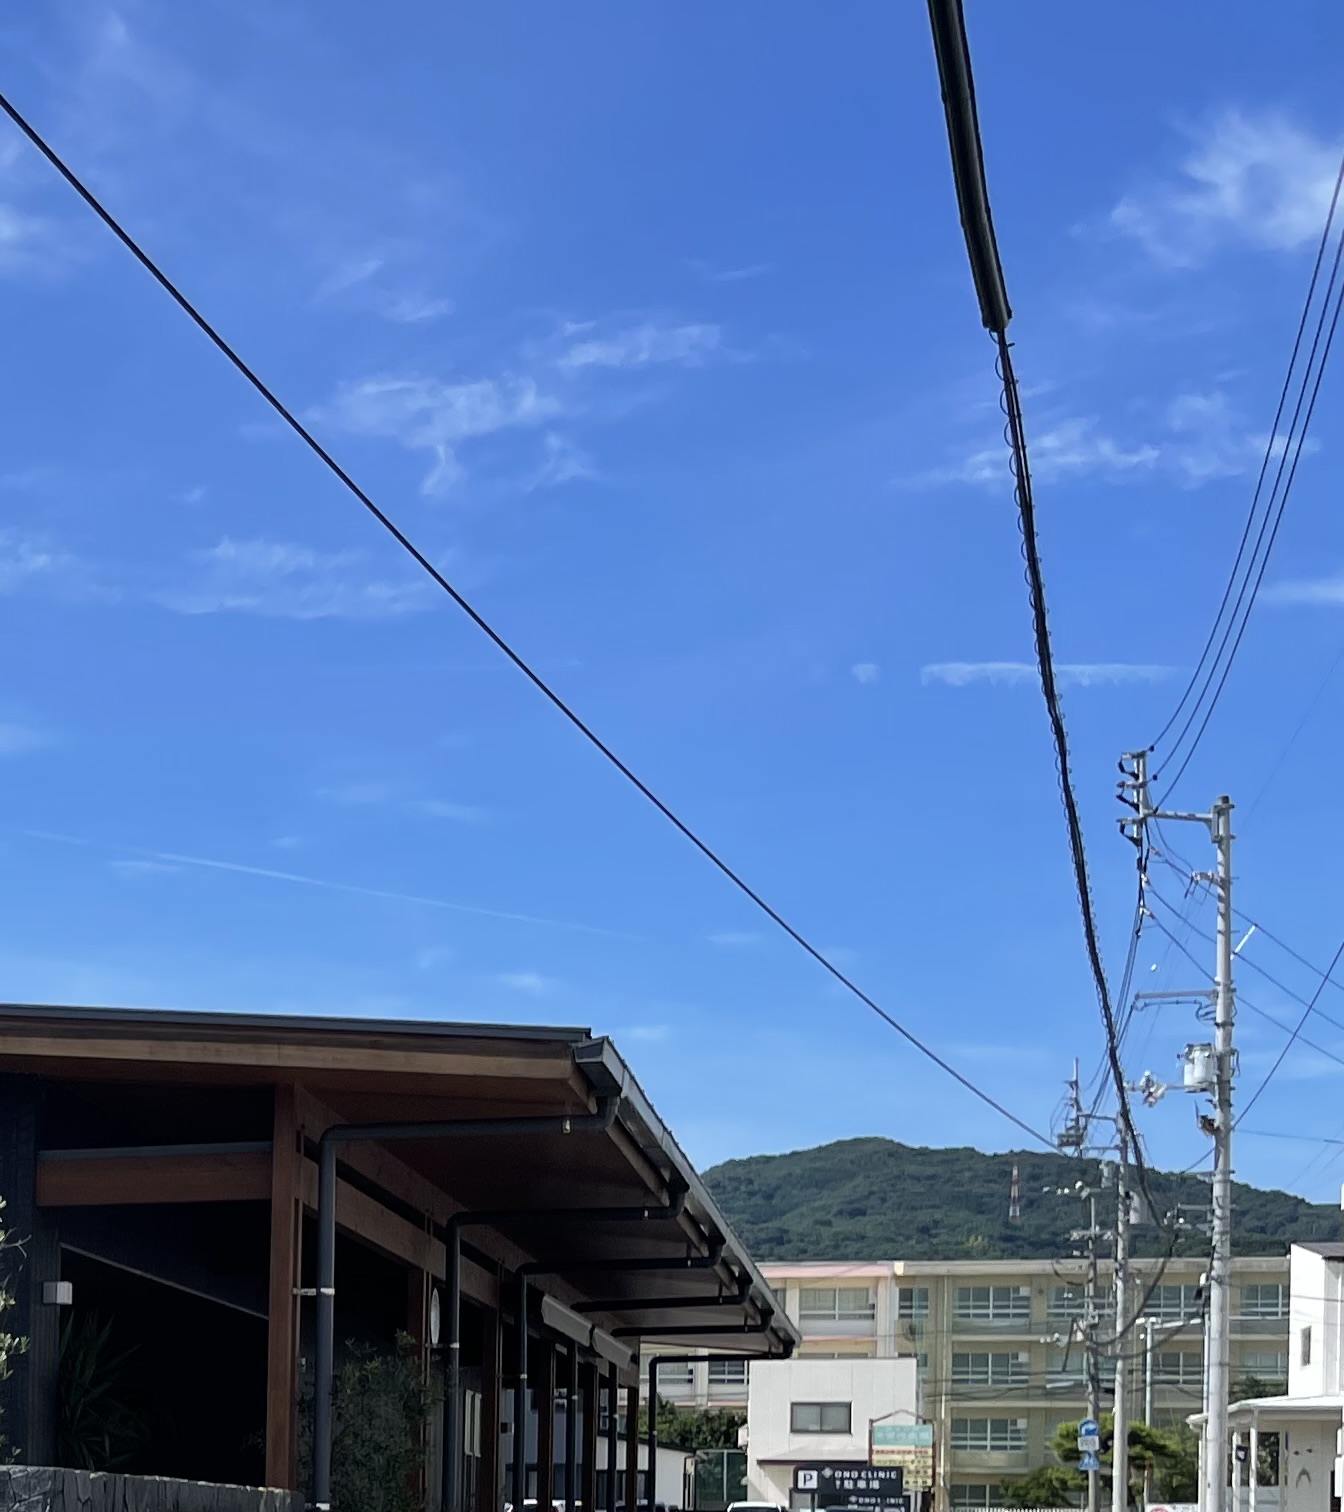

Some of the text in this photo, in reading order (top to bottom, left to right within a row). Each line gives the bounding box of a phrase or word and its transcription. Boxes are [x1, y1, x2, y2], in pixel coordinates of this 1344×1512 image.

[803, 1472, 813, 1487] P
[834, 1470, 858, 1480] ONO
[860, 1470, 897, 1480] CLINIC
